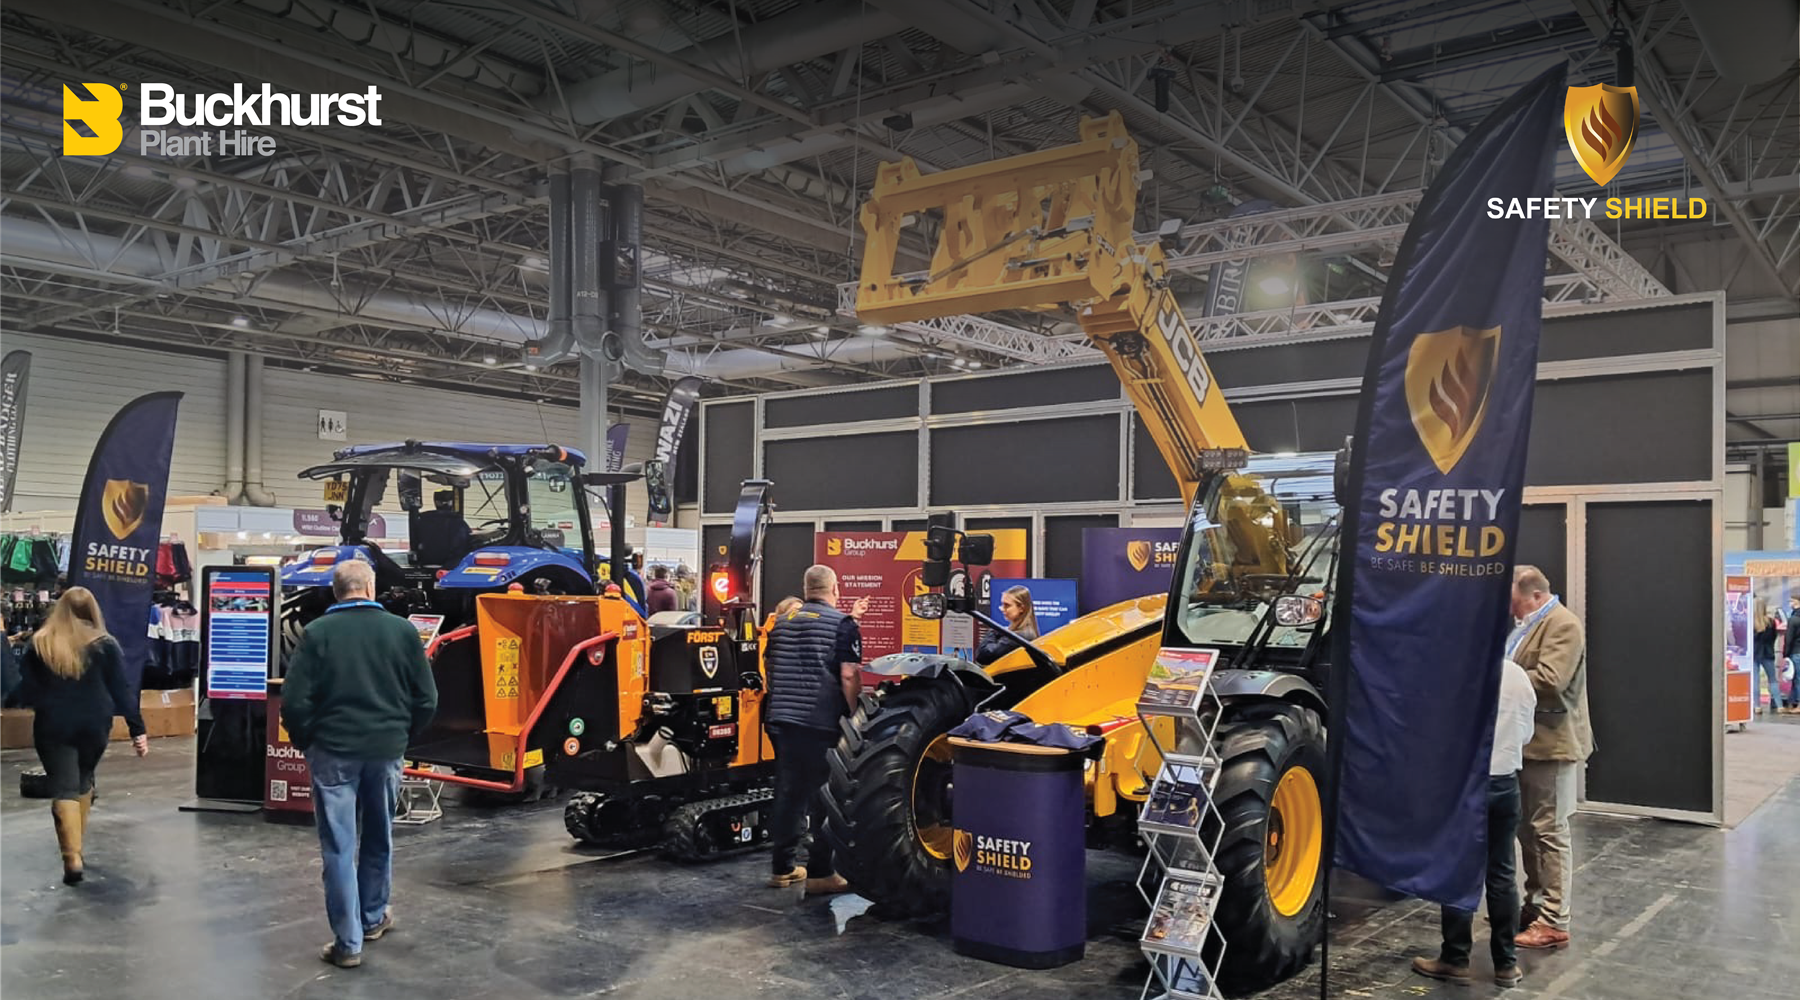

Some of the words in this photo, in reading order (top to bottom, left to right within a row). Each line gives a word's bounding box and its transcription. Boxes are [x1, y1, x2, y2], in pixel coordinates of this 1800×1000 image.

[1157, 308, 1210, 403] JCB
[655, 400, 683, 463] WAZI
[1379, 488, 1505, 520] SAFETY
[844, 538, 898, 550] Buckhurst
[1375, 522, 1505, 557] SHIELD
[87, 542, 151, 562] SAFETY
[85, 557, 149, 577] SHIELD
[1371, 557, 1383, 569] BE
[1387, 558, 1414, 572] SAFE
[1421, 561, 1436, 574] BE
[1439, 562, 1505, 576] SHIELDED
[687, 630, 725, 643] FÖRST
[277, 760, 306, 774] Group
[976, 835, 1031, 856] SAFETY
[976, 850, 1032, 871] SHIELD
